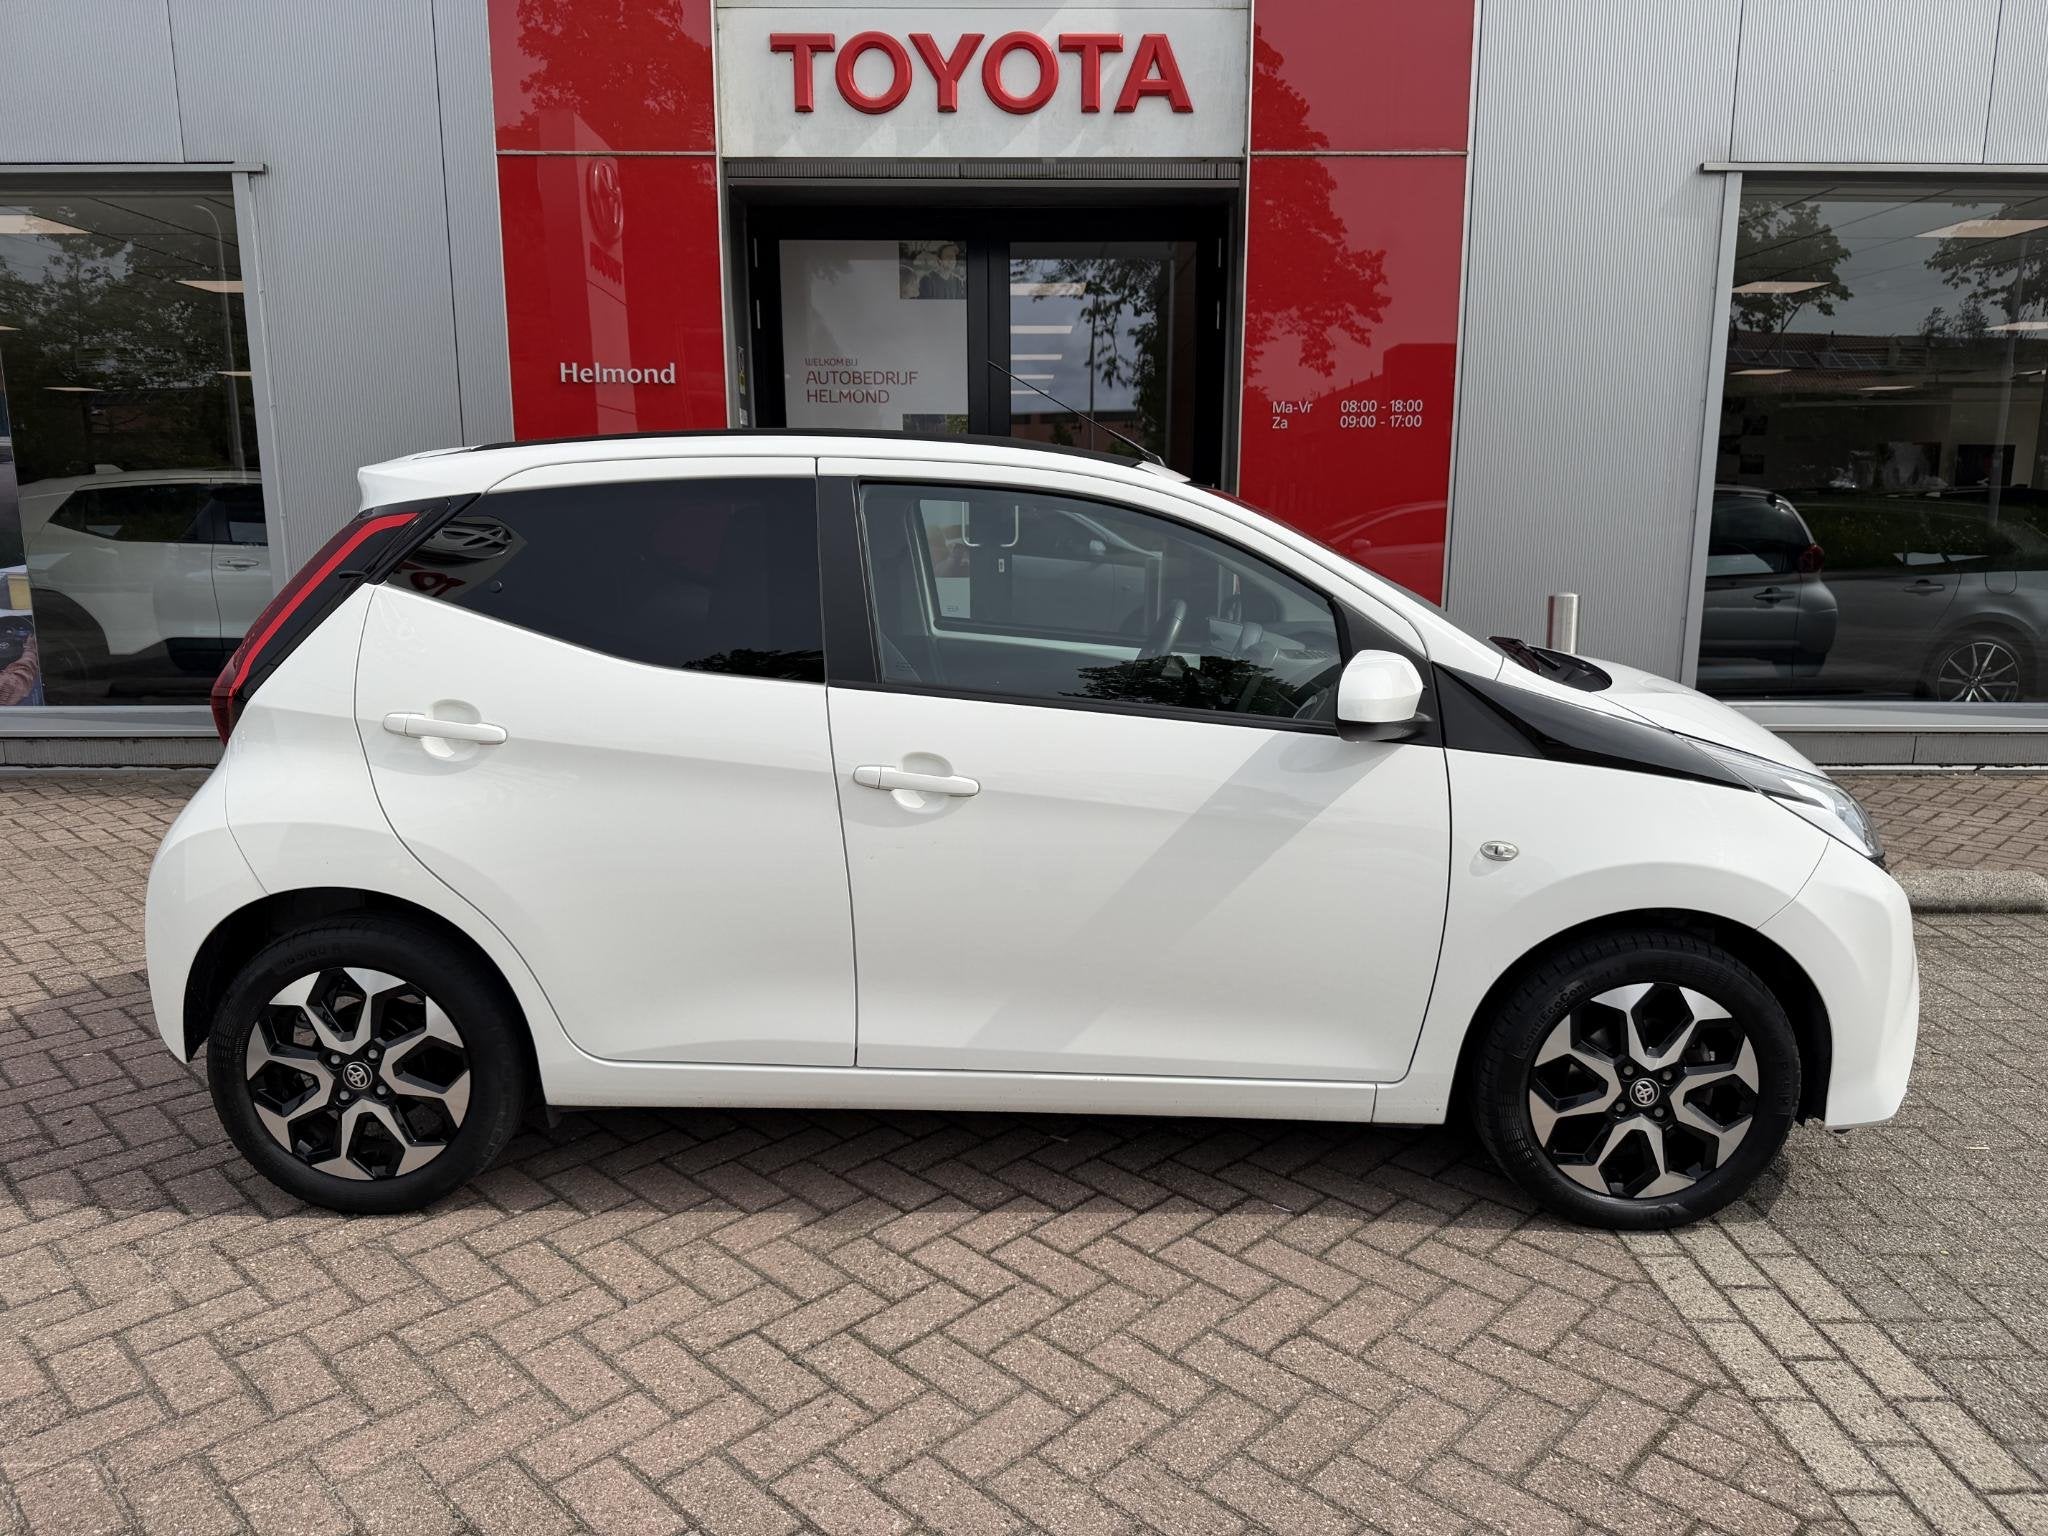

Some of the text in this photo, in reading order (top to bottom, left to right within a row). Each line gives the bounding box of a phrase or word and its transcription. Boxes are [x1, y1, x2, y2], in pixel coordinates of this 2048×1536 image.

[769, 30, 1194, 115] TOYOTA
[804, 358, 858, 367] WELKOM BIJ
[560, 361, 676, 384] Helmond
[805, 370, 919, 385] AUTOBEDRIJF
[806, 389, 890, 404] HELMOND
[1272, 400, 1313, 414] Ma-Vr
[1340, 400, 1377, 413] 08:00
[1389, 399, 1423, 412] 18:00
[1272, 416, 1289, 429] Za
[1339, 415, 1376, 428] 09:00
[1389, 414, 1422, 428] 17:00
